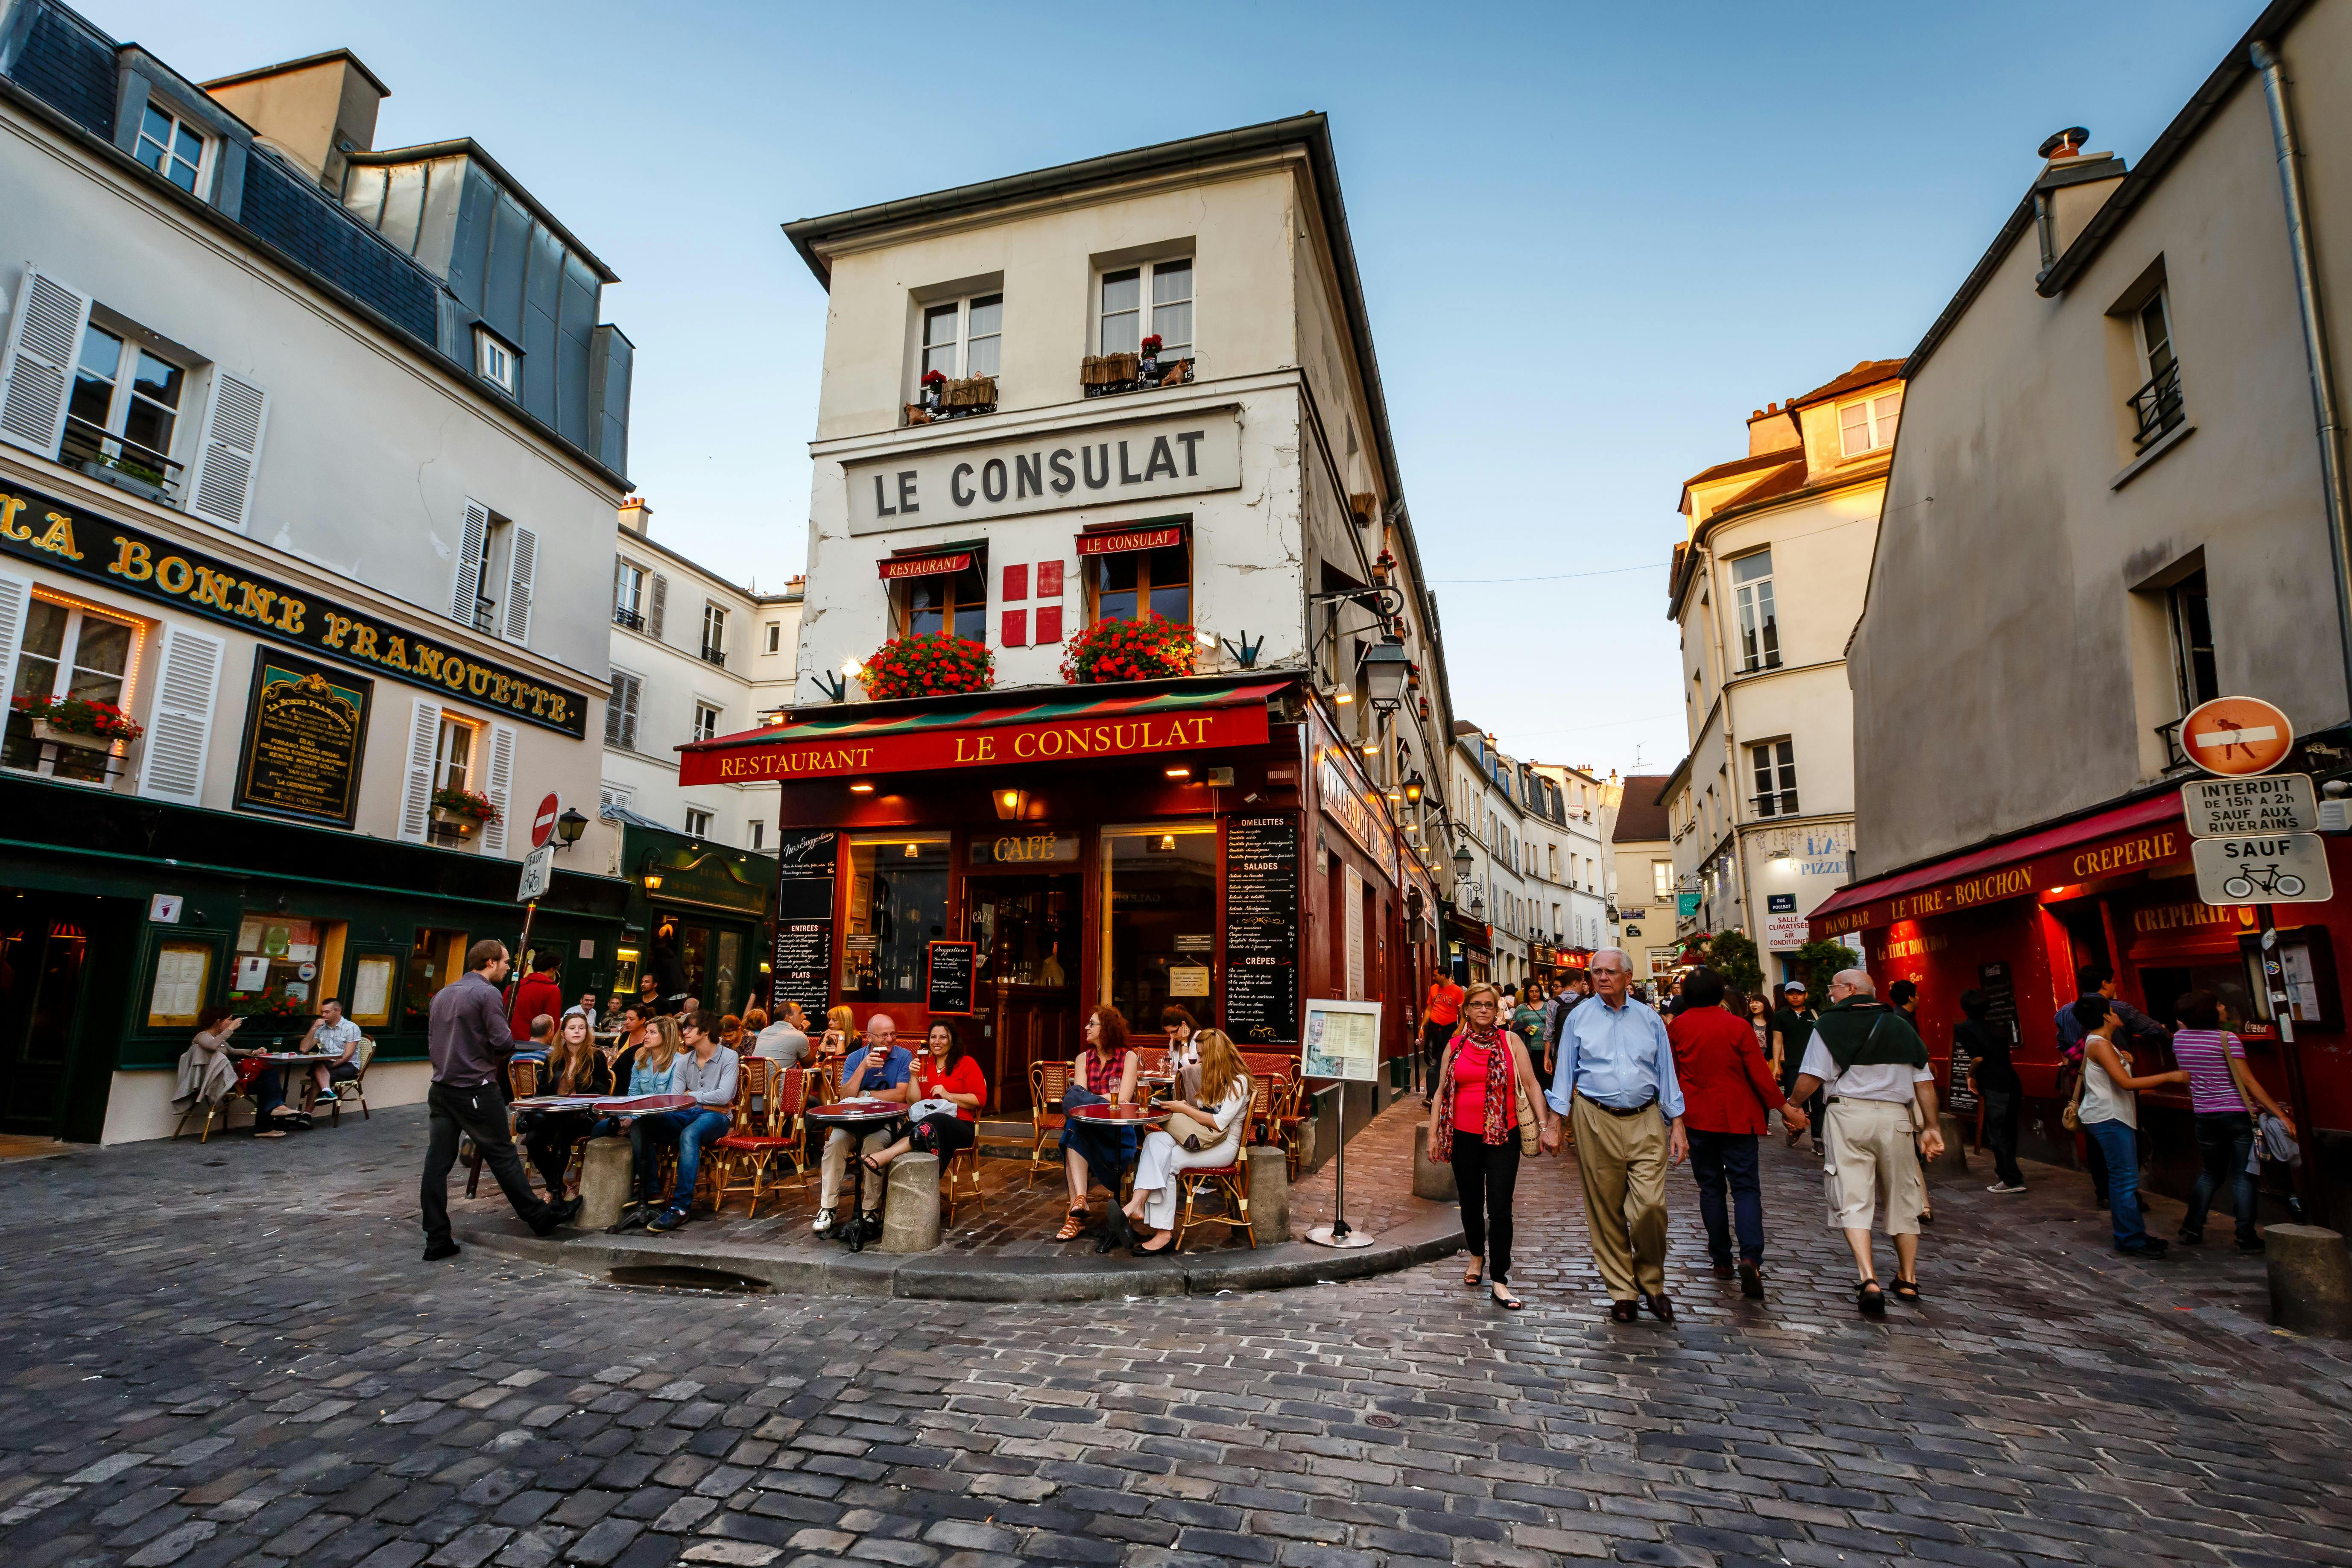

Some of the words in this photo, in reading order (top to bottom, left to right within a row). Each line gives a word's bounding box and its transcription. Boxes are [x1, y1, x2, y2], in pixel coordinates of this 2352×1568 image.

[875, 470, 920, 518] LE
[951, 430, 1205, 508] CONSULAT
[1086, 537, 1102, 552] LE
[1107, 530, 1170, 550] CONSULAT
[889, 556, 959, 576] RESTAURANT
[0, 494, 84, 561] LA
[108, 536, 306, 635] BONNE
[322, 612, 566, 722] FRANQUETTE
[954, 736, 996, 763] LE
[1014, 717, 1214, 758] CONSULAT
[720, 748, 873, 776] RESTAURANT
[2202, 779, 2291, 798] INTERDIT
[1323, 764, 1369, 843] AMBASSADE
[1372, 825, 1379, 855] DE
[2205, 800, 2221, 809] DE
[2226, 796, 2253, 807] 15h
[2276, 794, 2294, 804] 2h
[1241, 818, 1284, 826] OMELETTES
[2212, 809, 2251, 821] SAUF
[2261, 807, 2292, 818] AUX
[2209, 818, 2298, 833] RIVERAINS
[993, 832, 1057, 861] CAFÉ
[1807, 837, 1840, 855] LA
[2074, 832, 2177, 876] CREPERIE
[2224, 840, 2291, 858] SAUF
[529, 851, 543, 866] SAUF
[1892, 900, 1907, 920] LE
[1913, 890, 1943, 915] TIRE
[1955, 866, 2032, 906] BOUCHON
[1825, 914, 1849, 935] PIANO
[1852, 910, 1869, 926] BAR
[2135, 901, 2230, 931] CREPERIE
[1769, 922, 1809, 930] CLIMATISÉE
[934, 946, 967, 956] Suggestions
[1888, 941, 1907, 959] TIRE
[1246, 956, 1275, 965] CRÊPES
